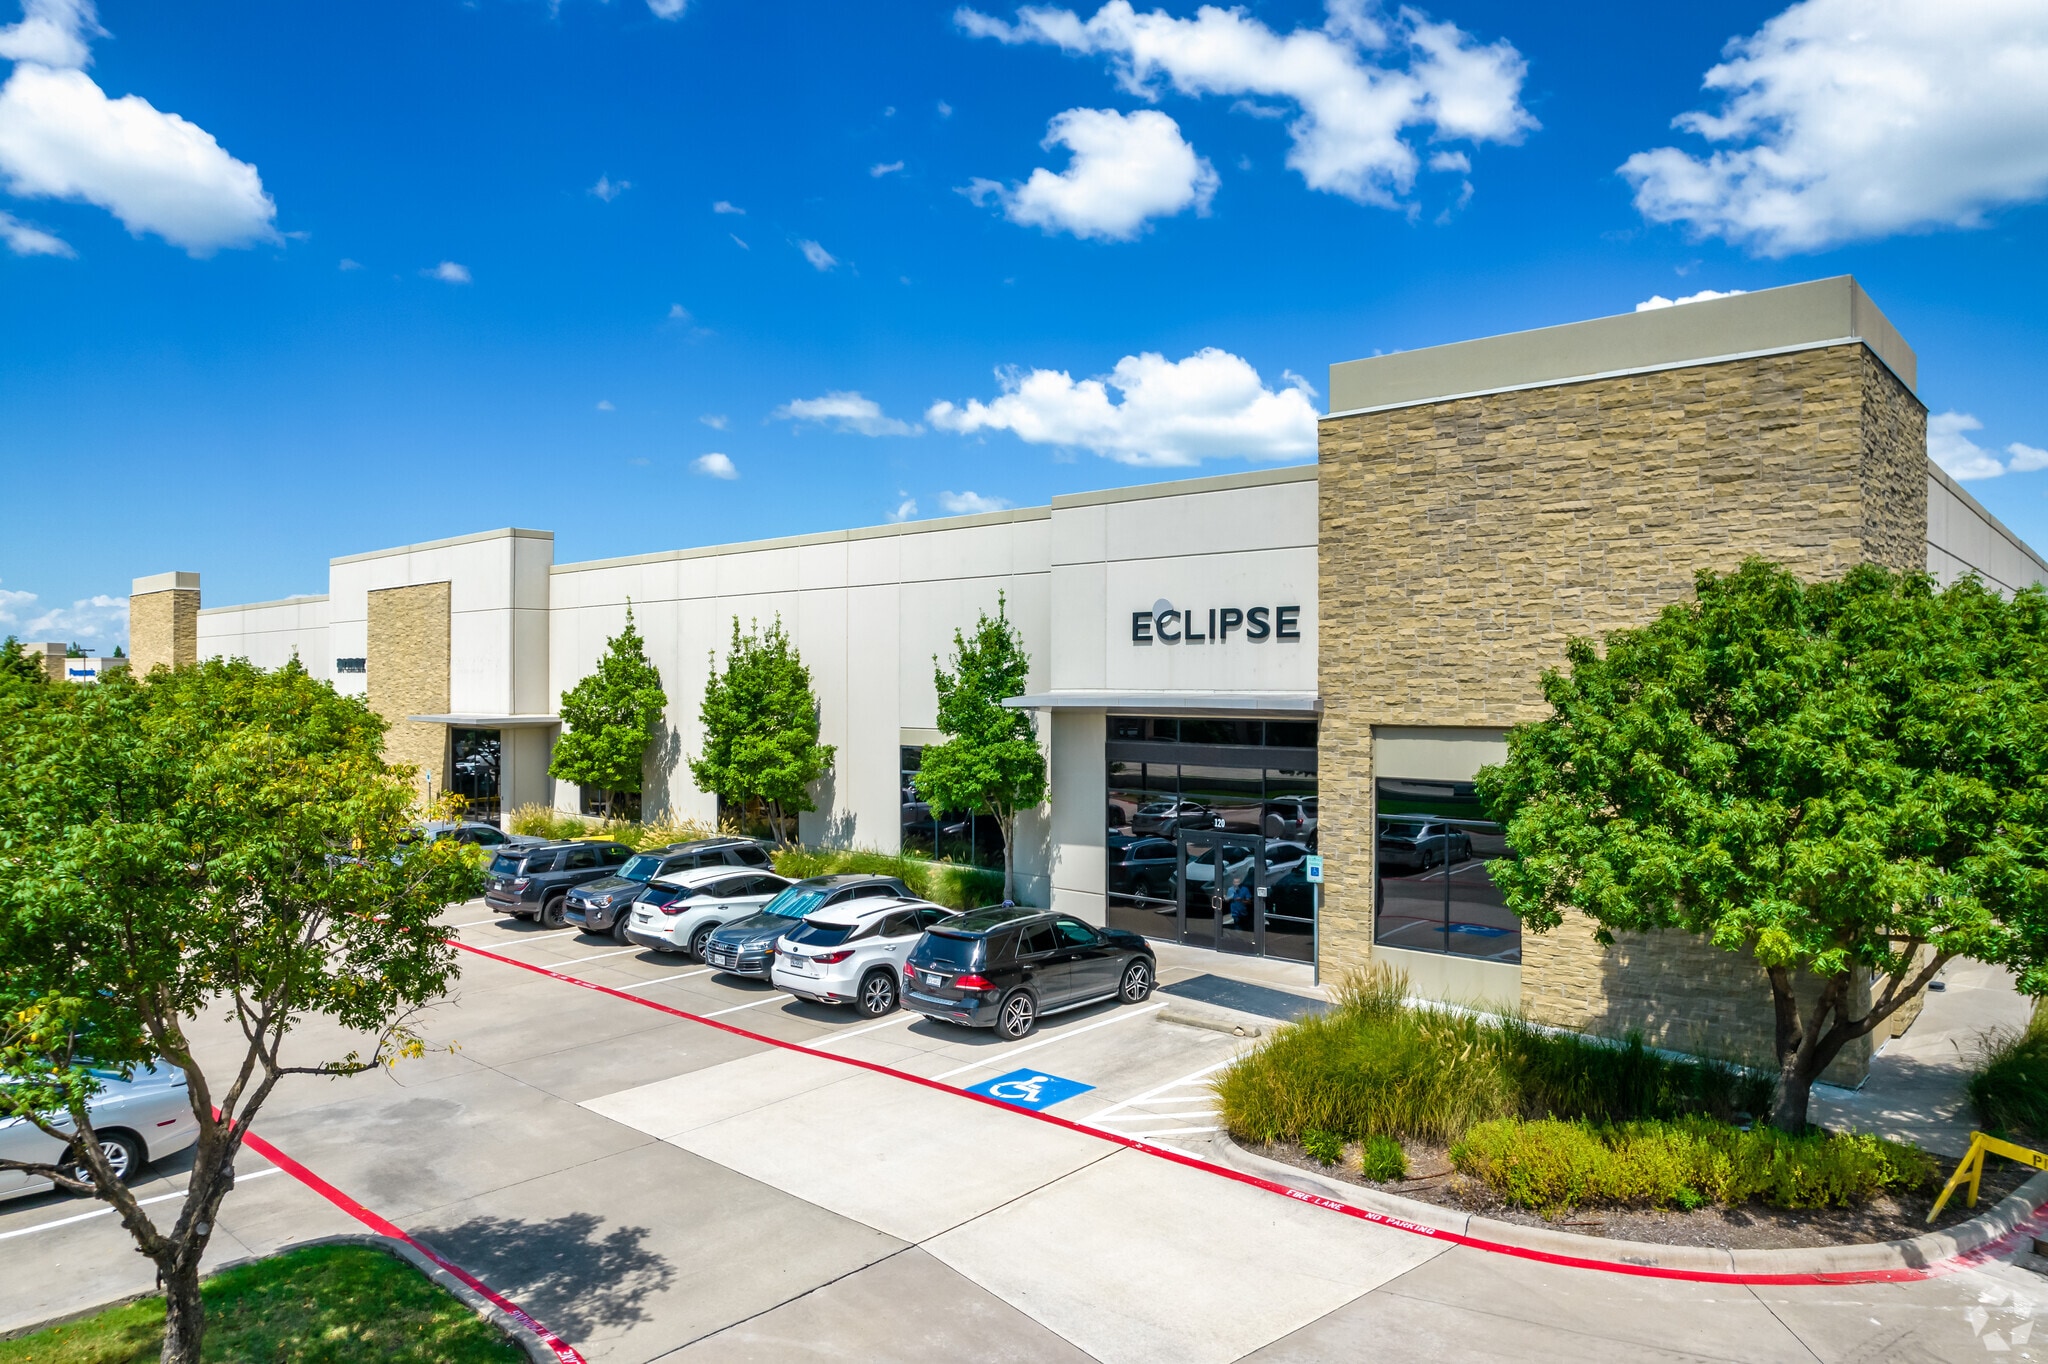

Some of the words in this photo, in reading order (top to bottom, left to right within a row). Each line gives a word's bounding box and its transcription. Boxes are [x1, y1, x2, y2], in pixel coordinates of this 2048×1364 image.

[1132, 605, 1301, 642] ECLIPSE
[1214, 818, 1225, 828] 120
[1286, 1189, 1313, 1201] FIRE
[1314, 1198, 1344, 1211] LANE
[1365, 1212, 1382, 1221] NO
[1386, 1218, 1436, 1235] PARKING
[556, 1349, 581, 1364] ANE
